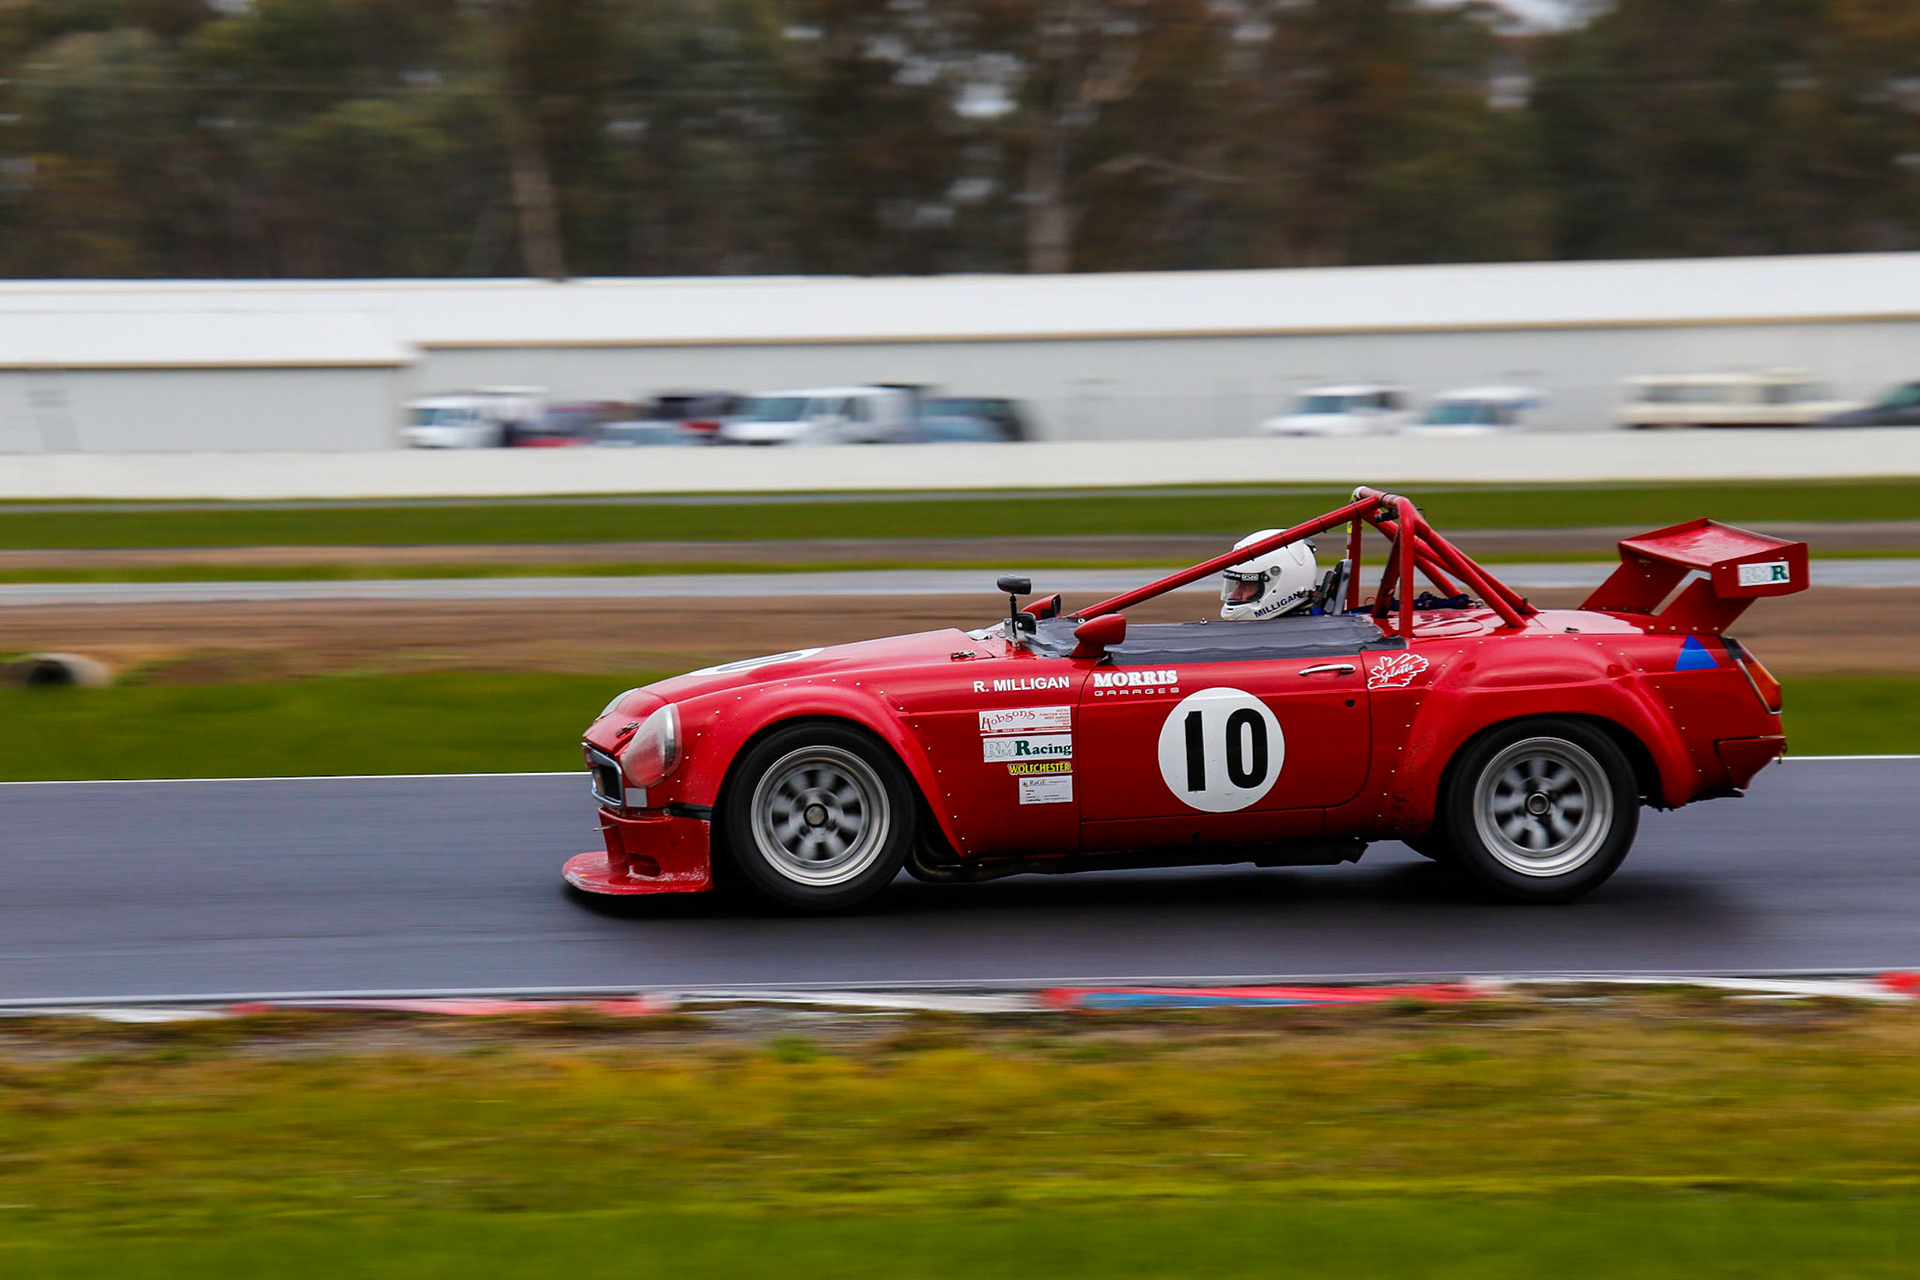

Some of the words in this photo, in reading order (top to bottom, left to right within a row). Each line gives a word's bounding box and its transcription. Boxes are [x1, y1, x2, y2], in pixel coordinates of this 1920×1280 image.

[1739, 565, 1789, 584] RMR
[1253, 590, 1301, 618] MILLIGAN
[973, 680, 990, 693] R.
[993, 676, 1070, 692] MILLIGAN
[1093, 670, 1178, 687] MORRIS
[1094, 687, 1180, 697] GARAGES
[981, 710, 1036, 731] Hobsons
[1184, 708, 1268, 792] 10
[1008, 762, 1070, 774] WOLFCHESTER
